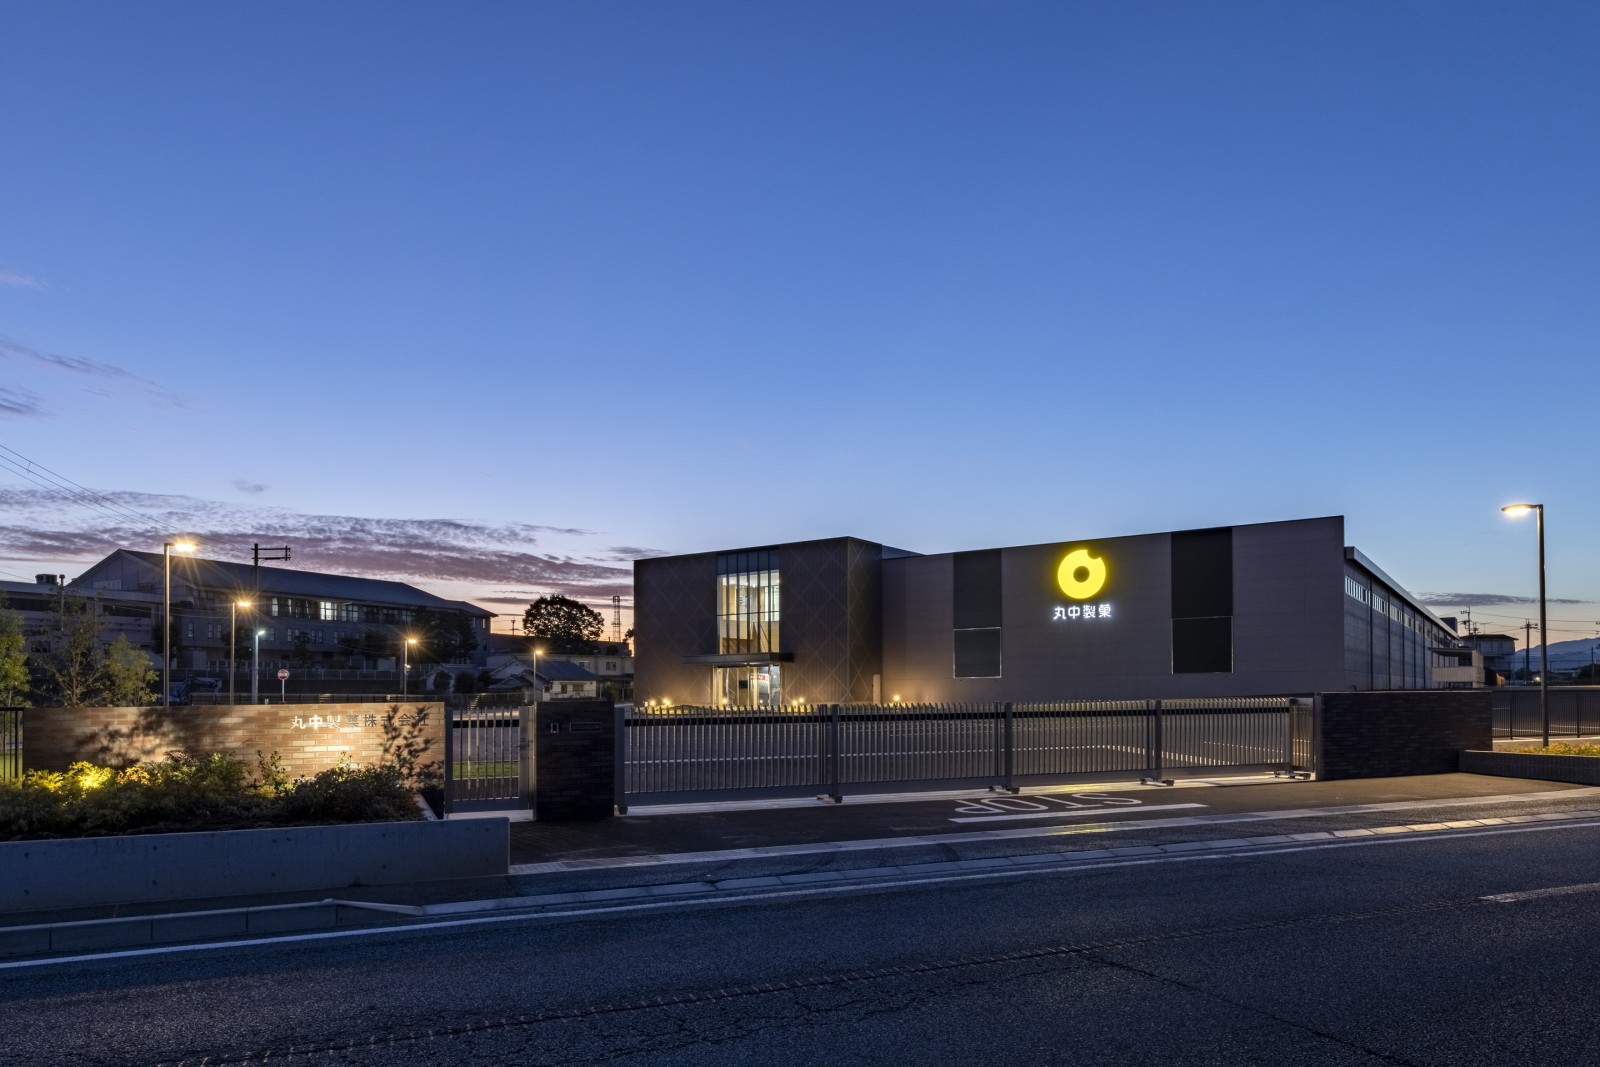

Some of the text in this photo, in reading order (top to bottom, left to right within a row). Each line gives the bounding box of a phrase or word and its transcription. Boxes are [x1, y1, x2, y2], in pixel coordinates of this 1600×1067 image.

[1053, 603, 1111, 620] 丸中製菓
[954, 793, 1142, 813] STOP
